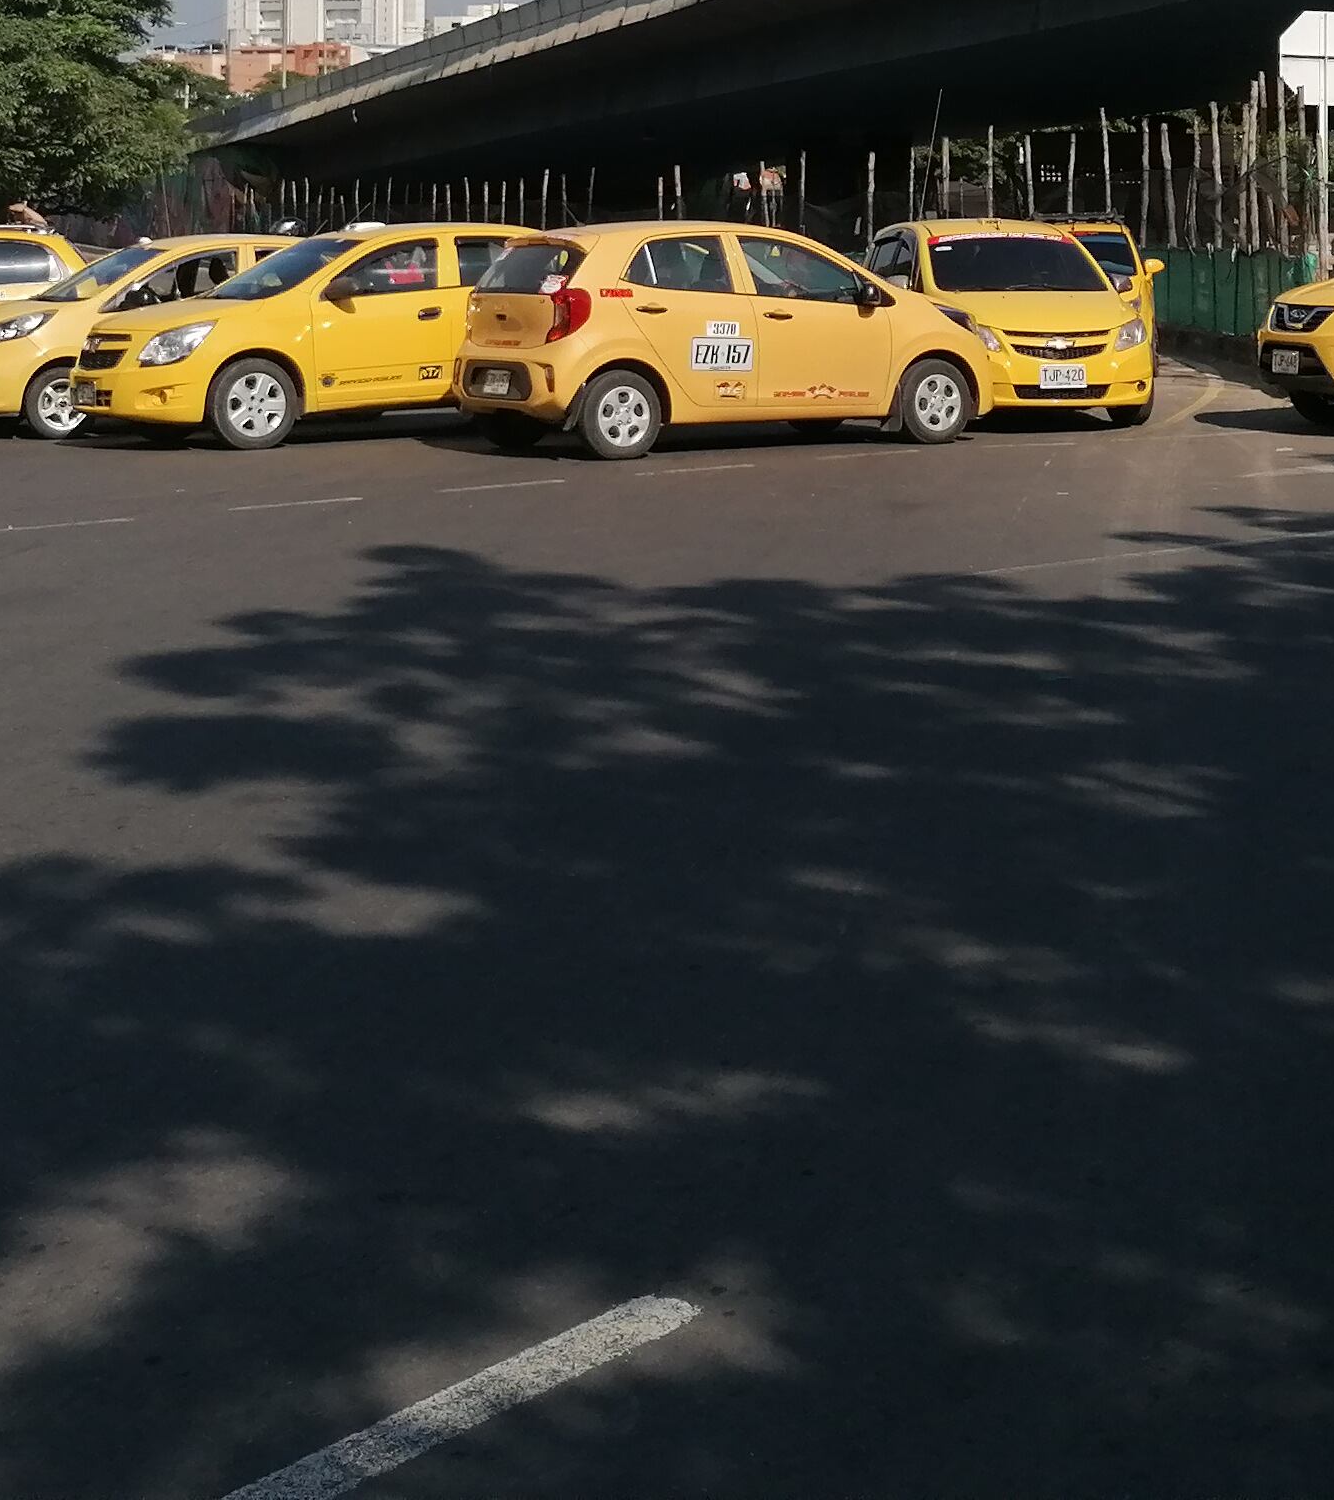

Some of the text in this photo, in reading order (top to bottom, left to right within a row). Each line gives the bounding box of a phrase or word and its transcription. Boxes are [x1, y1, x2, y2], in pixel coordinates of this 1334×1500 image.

[694, 344, 751, 364] EZK 157
[1042, 368, 1085, 382] TJP 420
